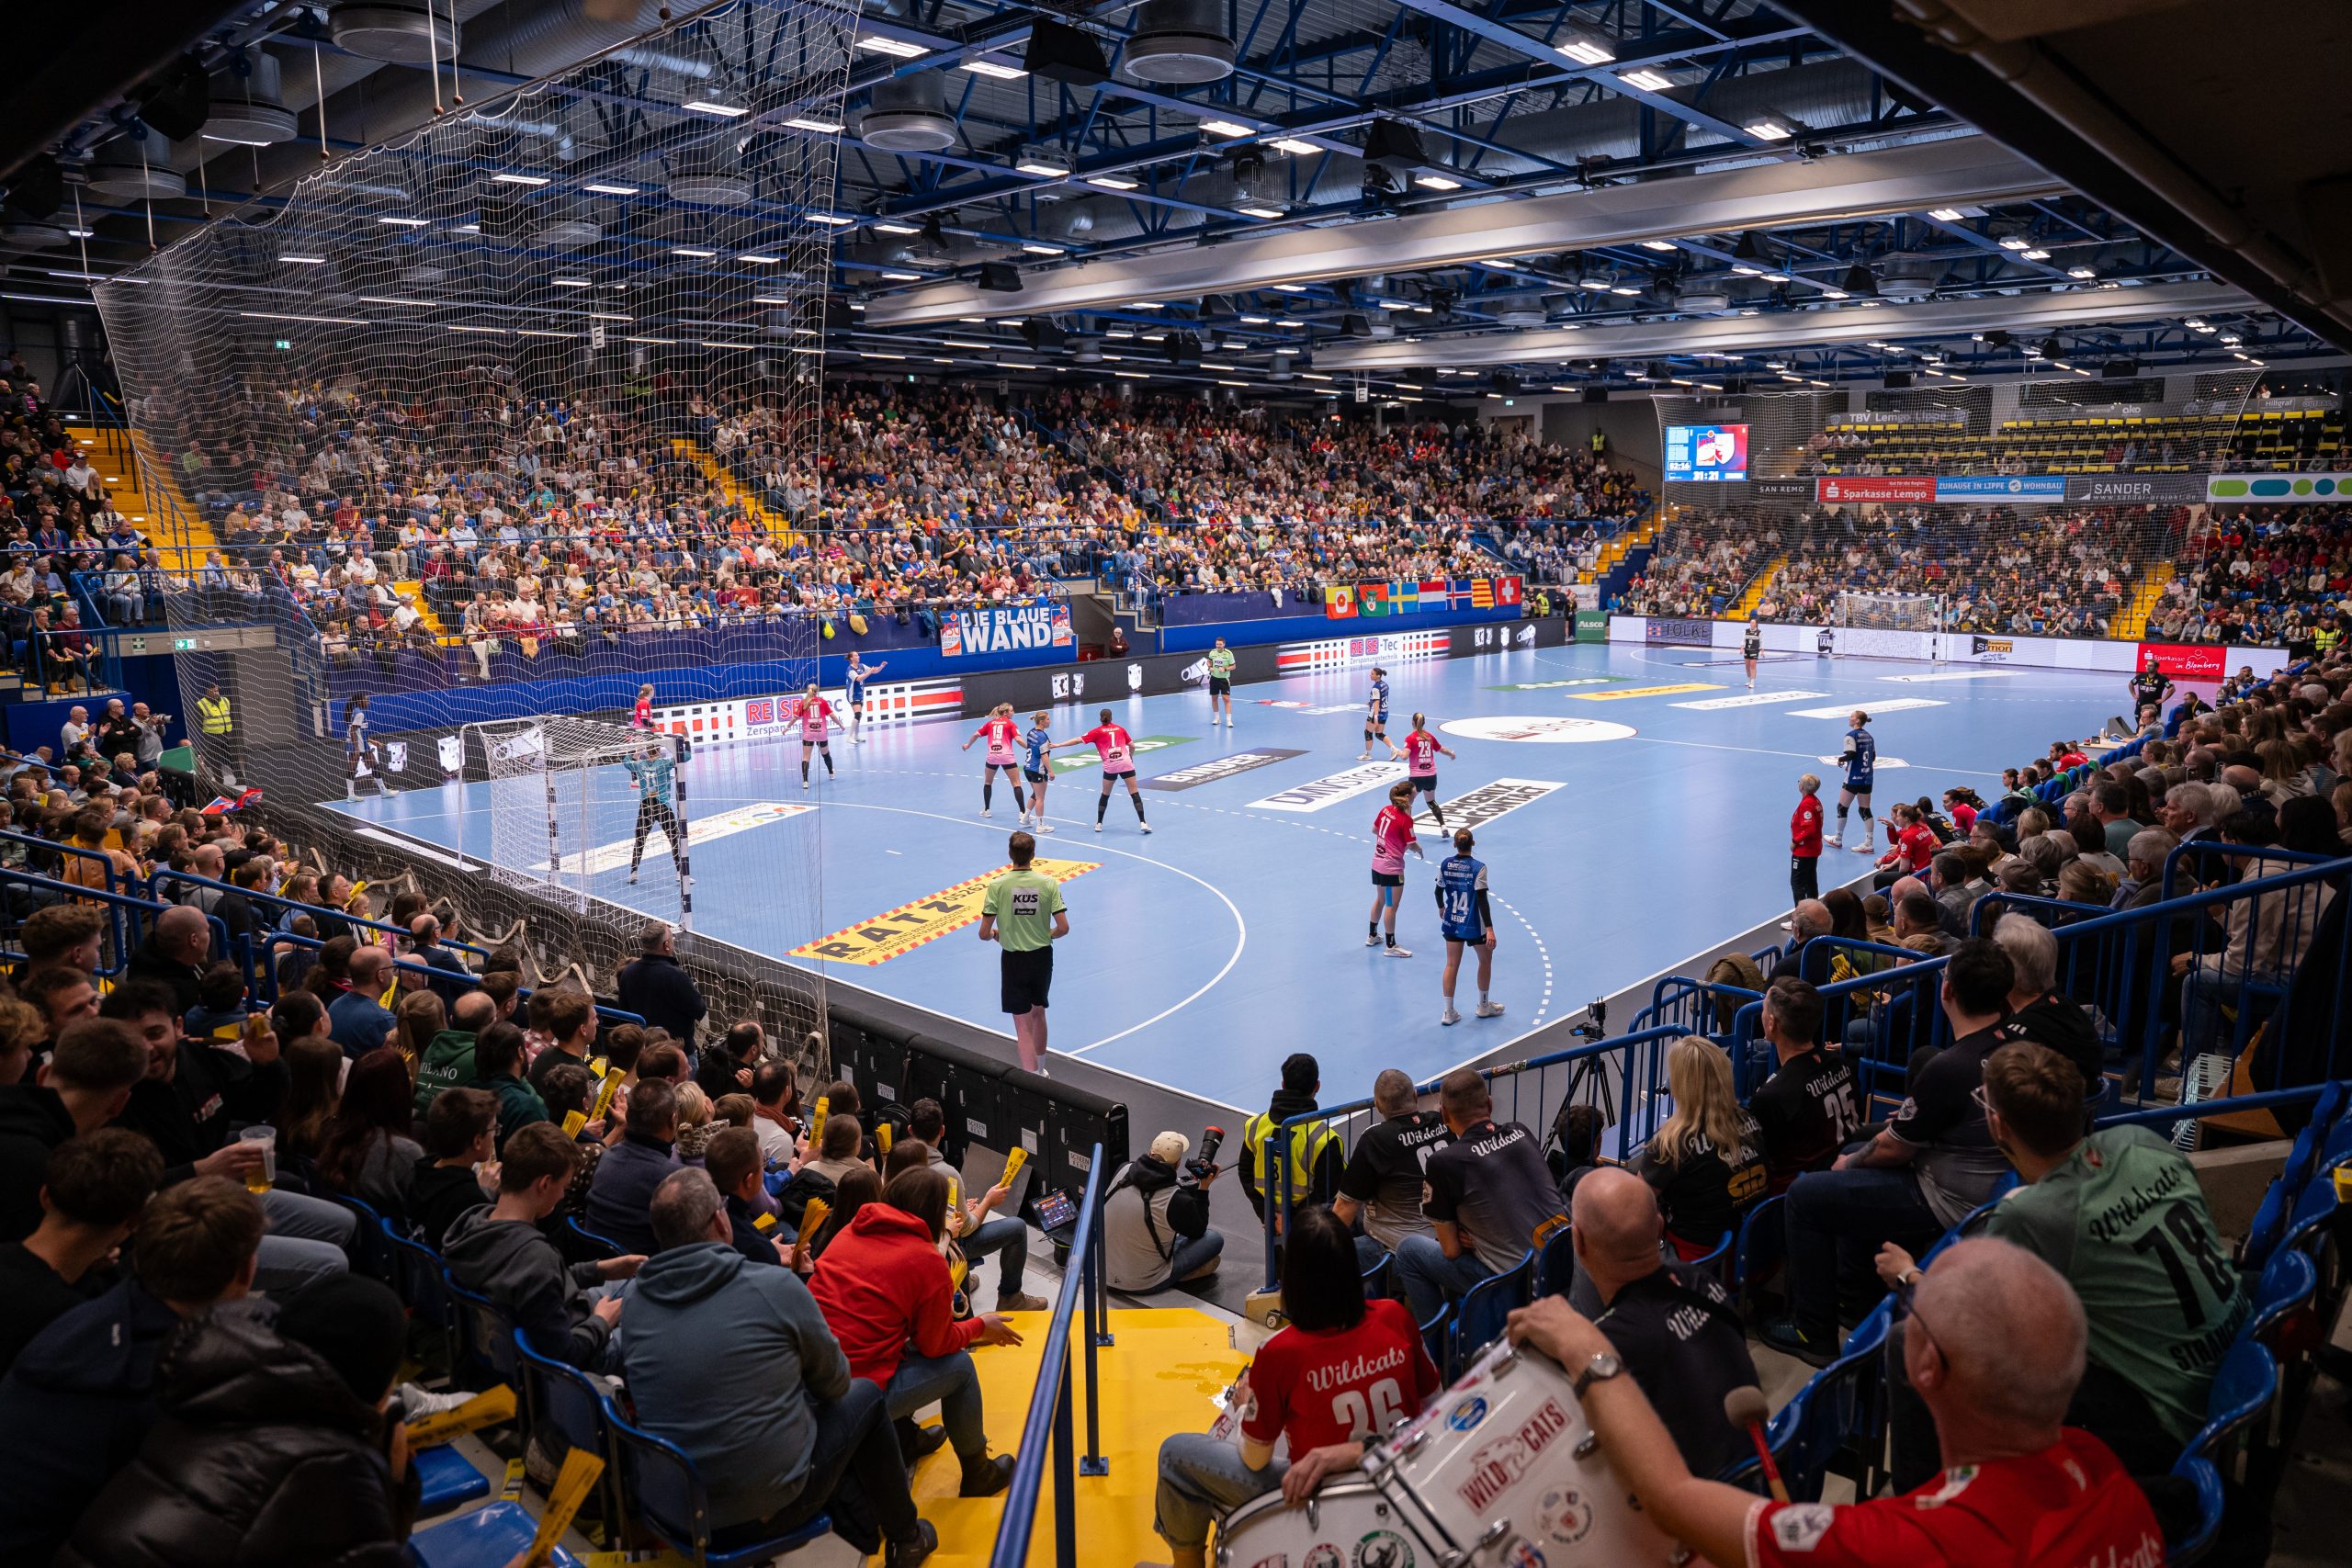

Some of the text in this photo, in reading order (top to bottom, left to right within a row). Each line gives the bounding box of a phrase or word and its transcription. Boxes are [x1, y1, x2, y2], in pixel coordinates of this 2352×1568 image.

[1849, 413, 1871, 423] TBV
[1875, 412, 1911, 423] Lemgo
[2121, 404, 2142, 413] ako
[1843, 490, 1927, 500] Sparkasse Lemgo
[2094, 483, 2152, 494] SANDER
[961, 606, 1050, 627] DIE BLAUE
[961, 622, 1051, 653] WAND
[1976, 642, 2012, 652] Simon
[2154, 654, 2186, 662] Sparkasse
[2185, 660, 2221, 670] Blomberg
[992, 724, 1004, 739] 19
[1418, 740, 1431, 758] 23
[1153, 752, 1272, 783] BINDER
[1862, 750, 1870, 767] 9
[1467, 784, 1552, 818] CONTACT
[943, 883, 989, 902] 05262
[1012, 894, 1038, 903] KÜS
[1451, 890, 1469, 916] 14
[1806, 1064, 1852, 1099] Wildcats
[967, 1119, 986, 1130] SCREEN
[1397, 1122, 1449, 1147] Wildcats
[1471, 1128, 1526, 1157] Wildcats
[1069, 1152, 1090, 1166] SCREEN
[1072, 1160, 1088, 1170] RENT
[2088, 1164, 2182, 1243] Wildcats
[2131, 1200, 2236, 1330] 78
[1306, 1346, 1407, 1393] Wildcats
[1331, 1377, 1406, 1444] 26
[1464, 1460, 1509, 1509] WILD
[1521, 1403, 1566, 1452] CATS
